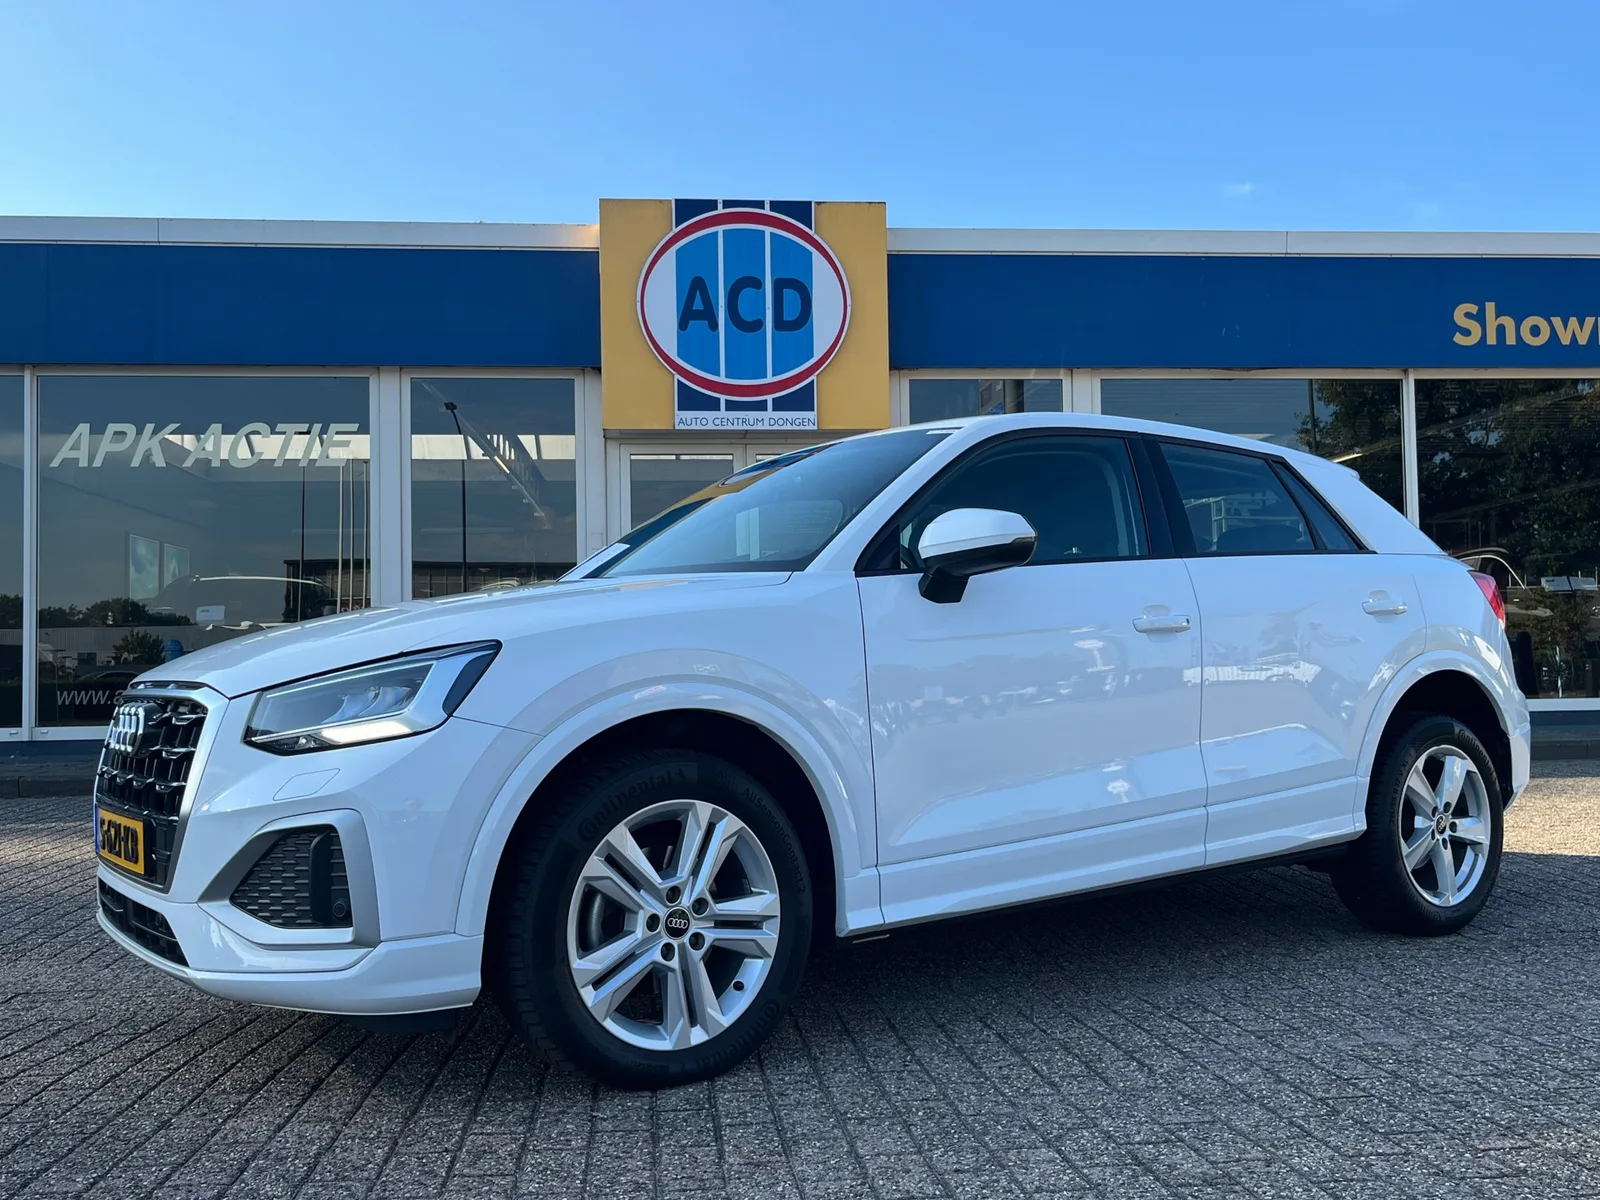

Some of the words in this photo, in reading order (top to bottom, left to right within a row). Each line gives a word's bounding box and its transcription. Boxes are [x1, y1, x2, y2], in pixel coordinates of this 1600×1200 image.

[678, 275, 812, 333] ACD
[1453, 301, 1600, 346] Show
[50, 422, 181, 468] APK
[183, 422, 360, 468] ACTIE
[677, 416, 708, 427] AUTO
[712, 416, 765, 427] CENTRUM
[768, 416, 816, 427] DONGEN
[1458, 728, 1495, 776] Continental
[577, 771, 673, 844] Continental
[742, 787, 804, 884] AllSeasonContact
